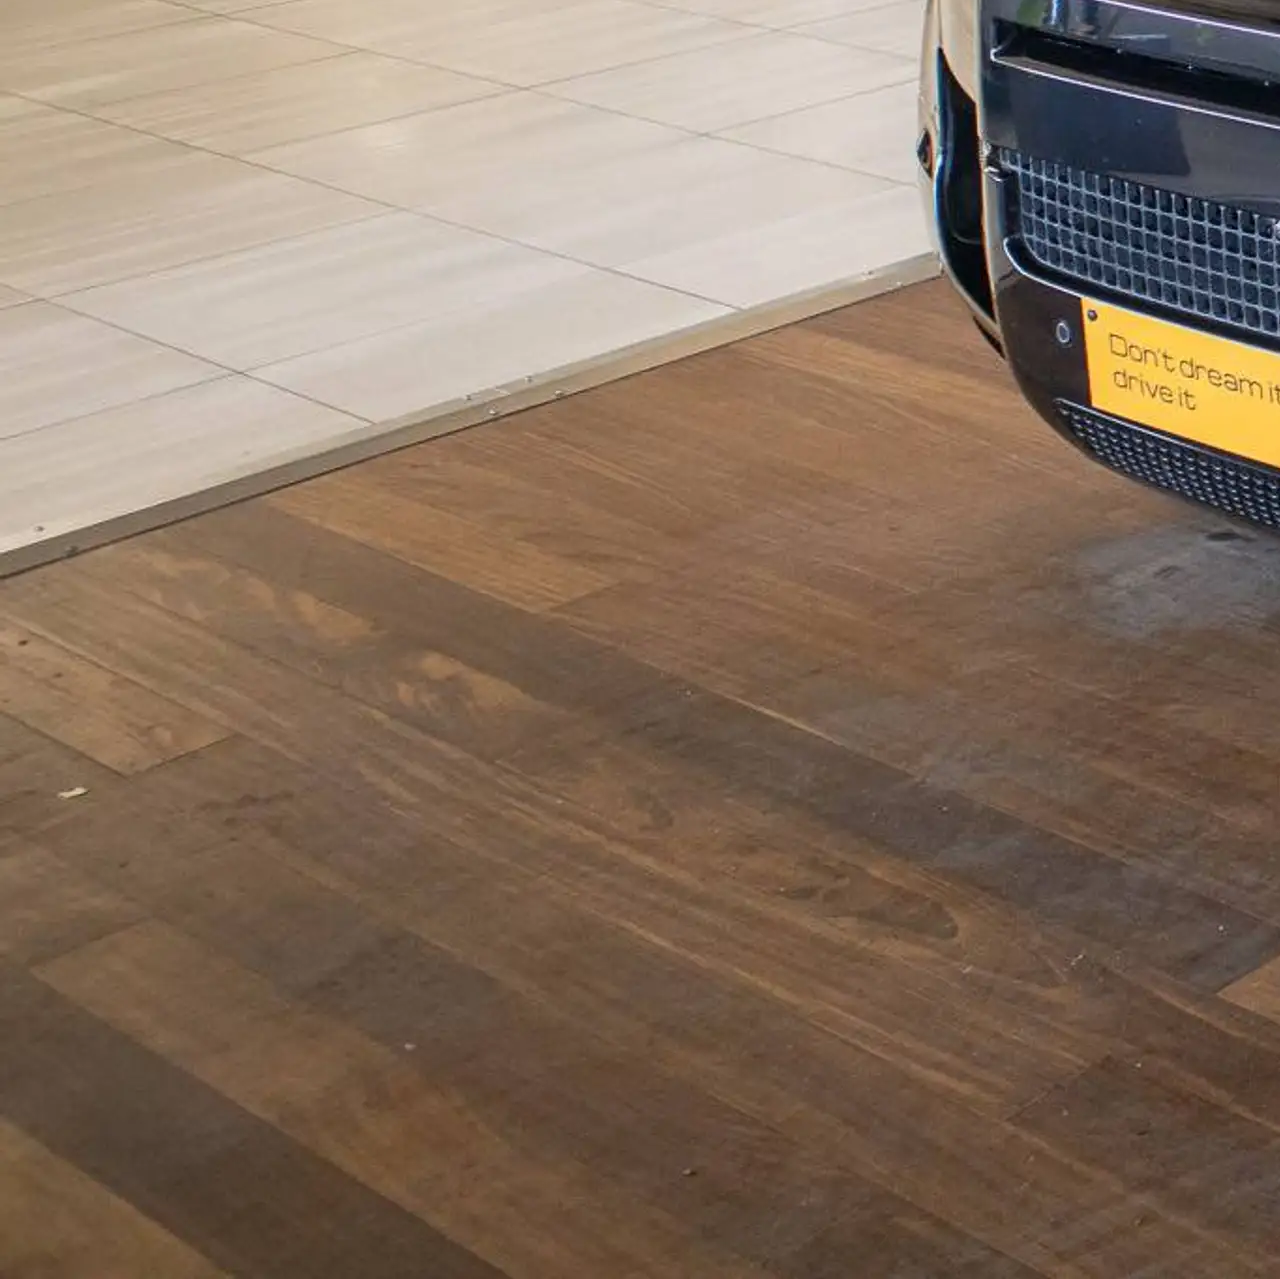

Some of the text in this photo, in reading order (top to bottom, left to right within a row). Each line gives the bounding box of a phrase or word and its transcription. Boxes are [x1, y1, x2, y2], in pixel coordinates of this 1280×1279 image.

[1108, 333, 1173, 374] Don't
[1179, 356, 1264, 400] dream
[1113, 367, 1197, 411] drive it
